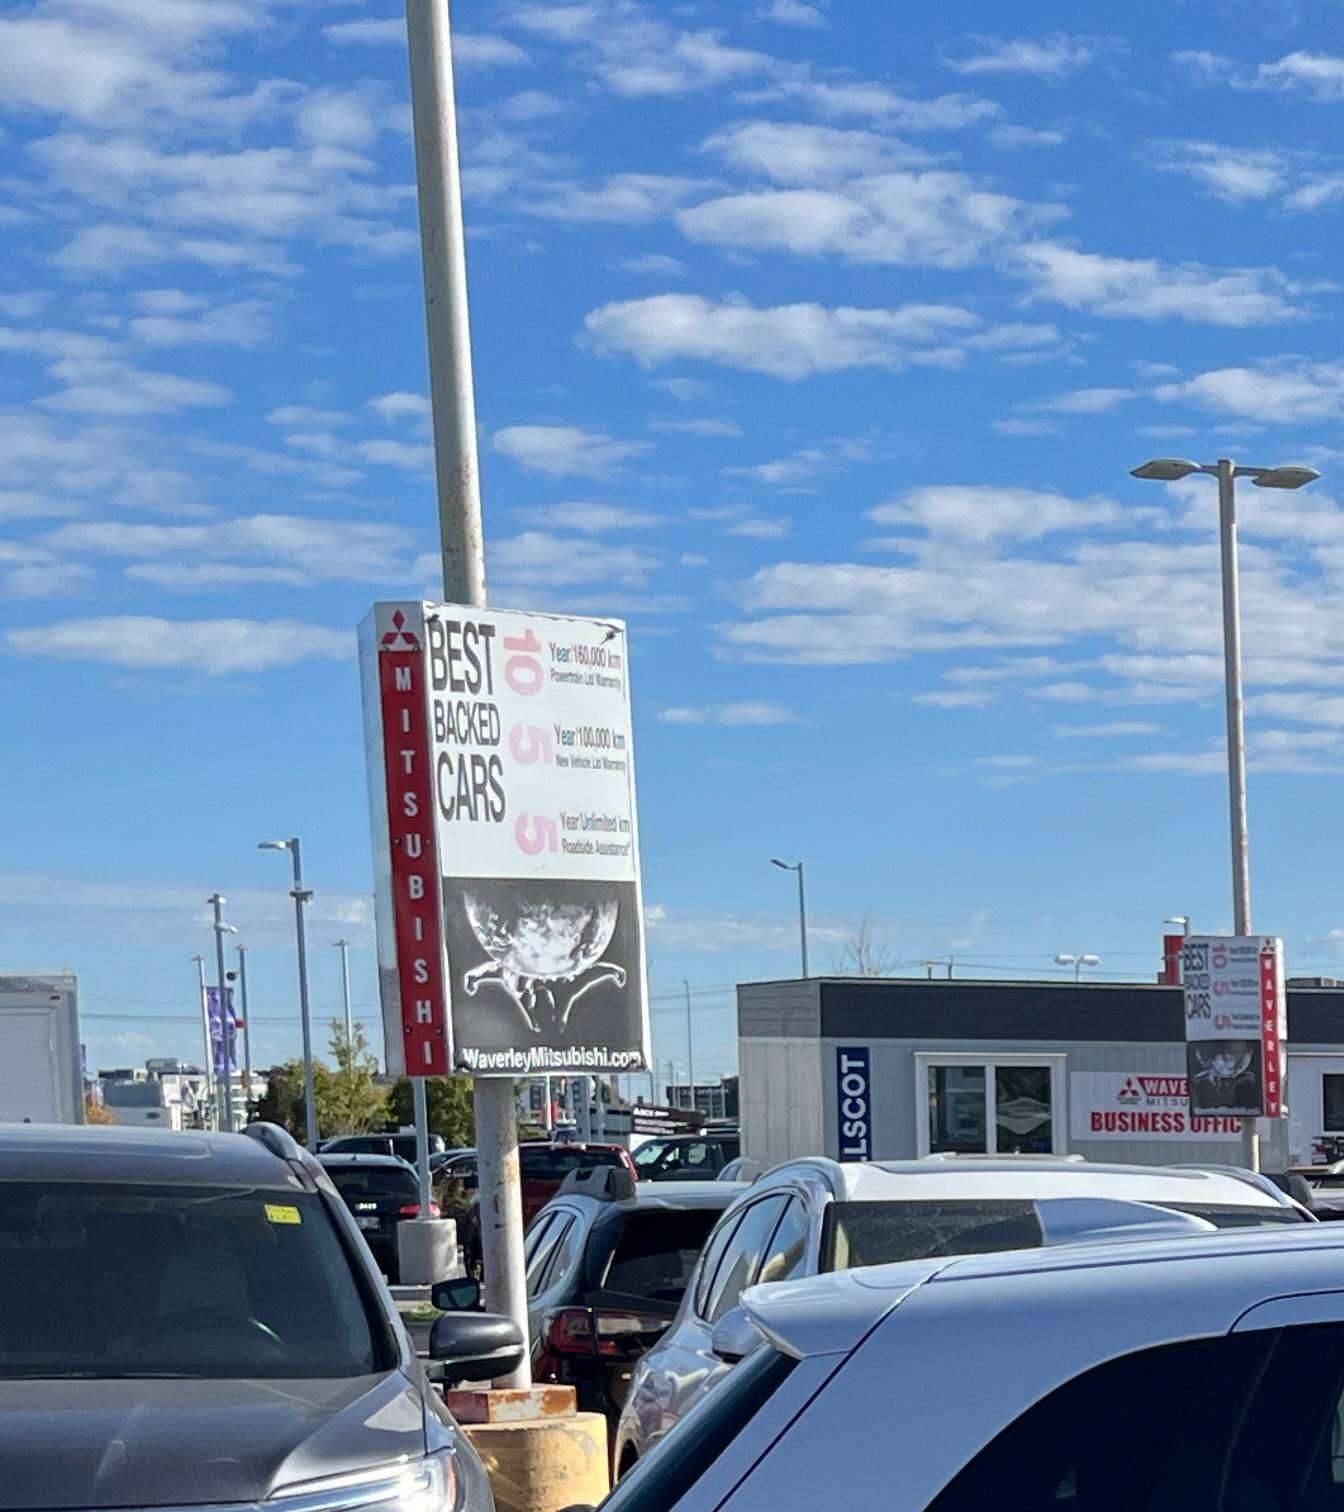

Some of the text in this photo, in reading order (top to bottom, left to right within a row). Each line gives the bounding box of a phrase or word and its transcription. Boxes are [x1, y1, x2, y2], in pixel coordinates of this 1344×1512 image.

[427, 620, 495, 695] BEST
[503, 628, 544, 696] 10
[608, 647, 622, 669] km
[434, 699, 501, 746] BACKED
[612, 729, 626, 749] km
[437, 751, 506, 823] CARS
[394, 665, 433, 1065] MITSUBISHI
[463, 1046, 641, 1072] WaverleyMitsubishi.com
[1264, 959, 1278, 1112] WAVERLEY
[841, 1054, 867, 1162] LSCOT
[1146, 1079, 1188, 1095] WAVE
[1146, 1098, 1189, 1106] MITSU
[1091, 1111, 1243, 1133] BUSINESS OFFIC
